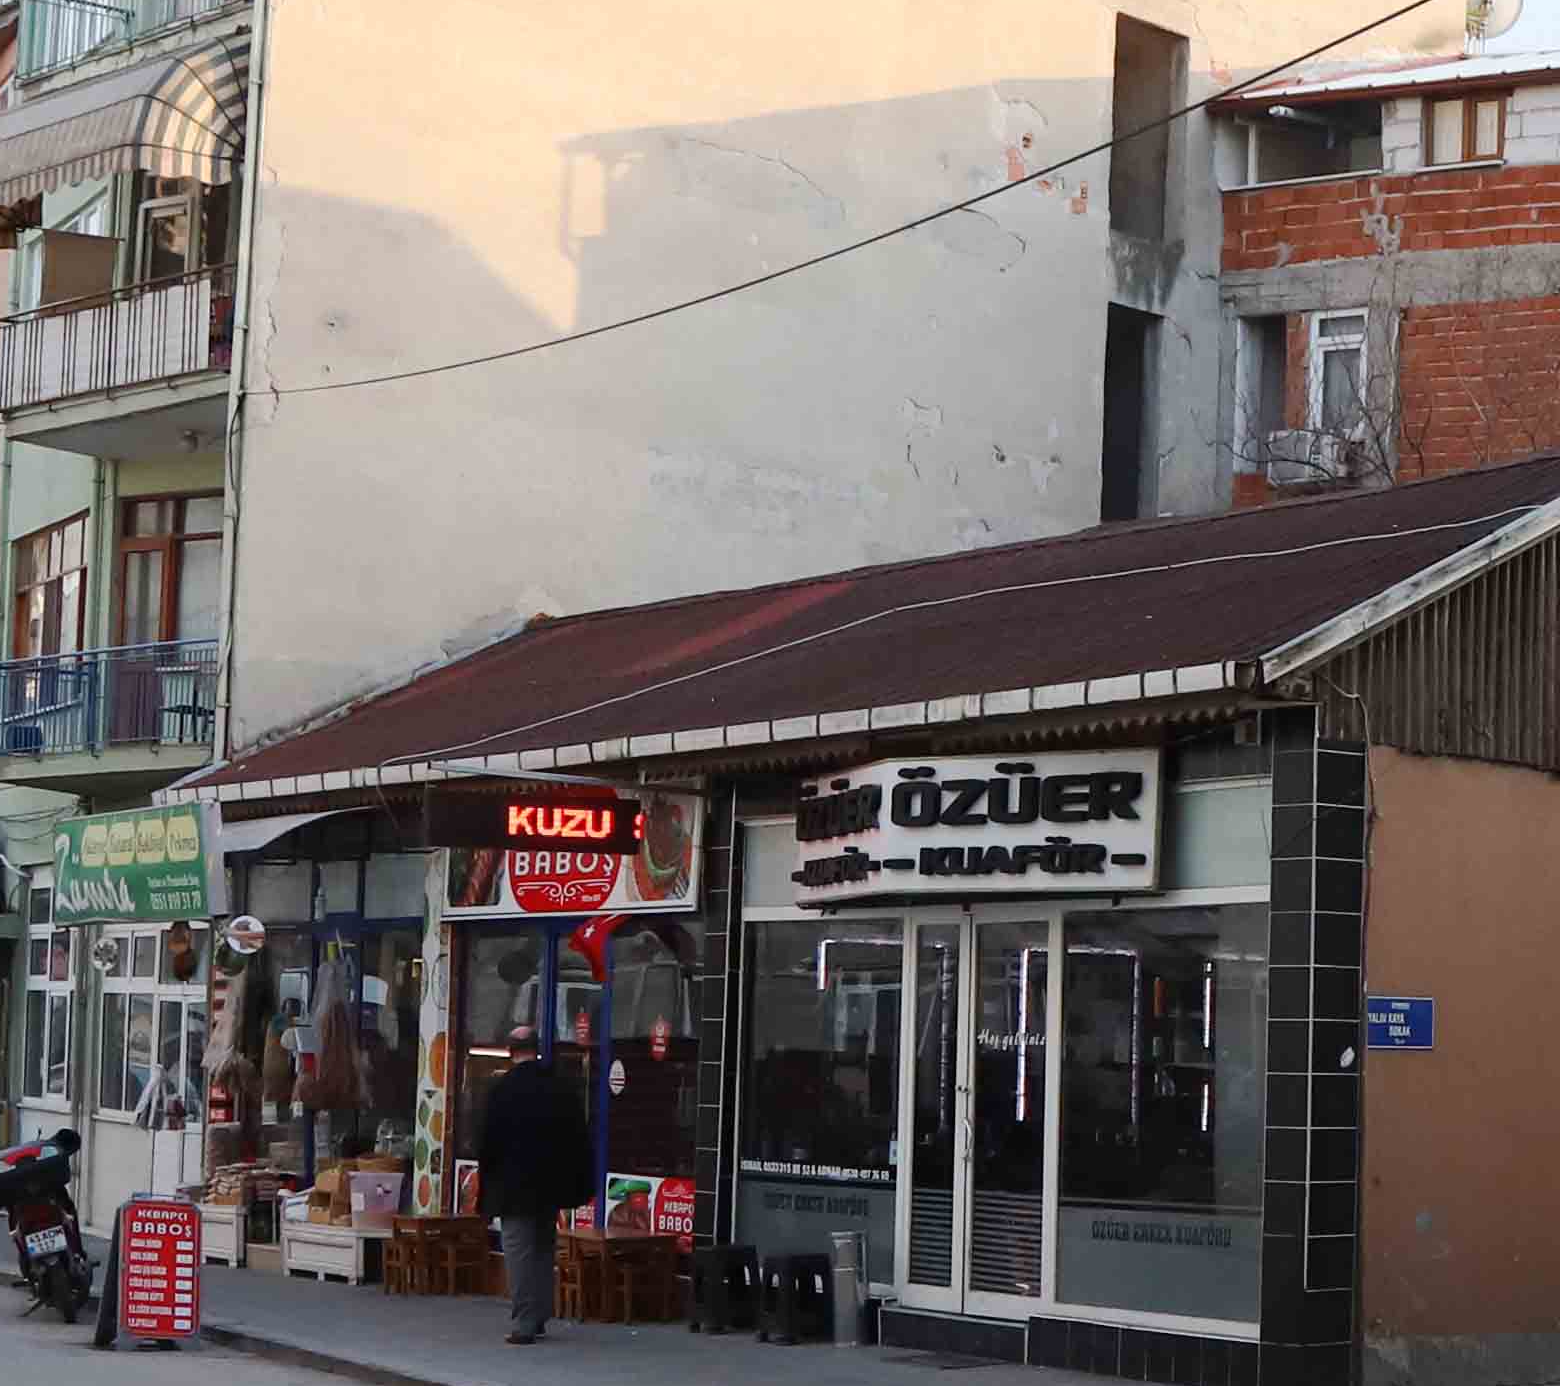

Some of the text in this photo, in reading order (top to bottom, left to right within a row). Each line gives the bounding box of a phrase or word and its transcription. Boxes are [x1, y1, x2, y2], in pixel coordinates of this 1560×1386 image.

[890, 761, 1144, 828] ÖZÜER
[507, 805, 612, 839] KUZU
[513, 850, 615, 877] BABOŞ
[918, 835, 1107, 875] KUAFÖR
[137, 1209, 188, 1222] KEBAPÇI
[658, 1214, 694, 1234] BABO
[131, 1221, 193, 1238] BABOŞ
